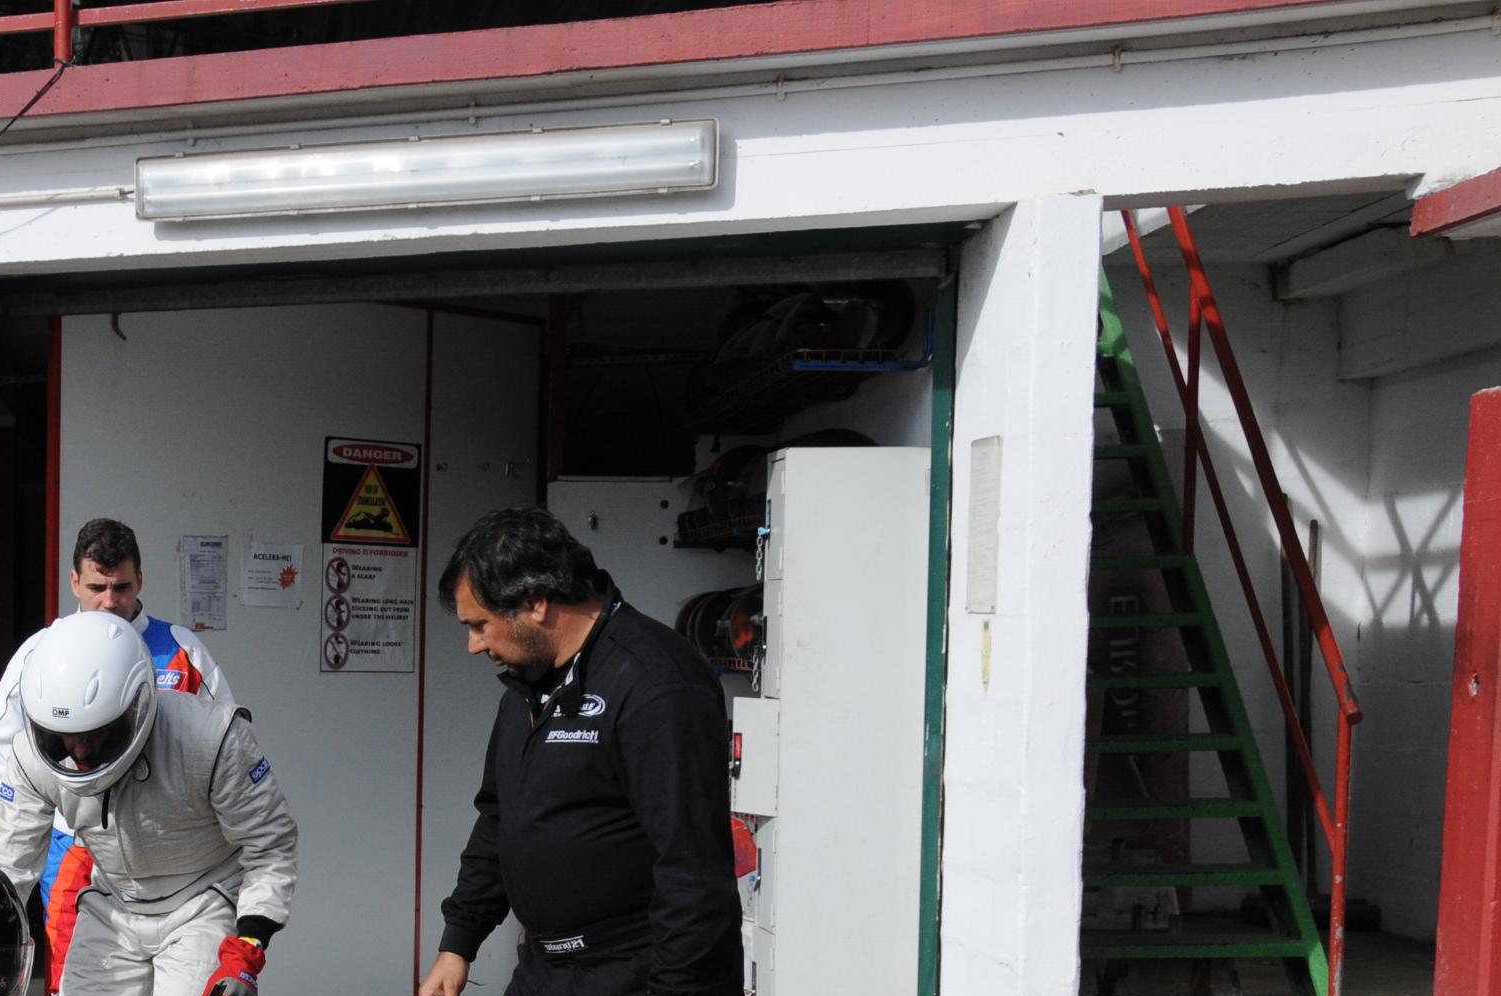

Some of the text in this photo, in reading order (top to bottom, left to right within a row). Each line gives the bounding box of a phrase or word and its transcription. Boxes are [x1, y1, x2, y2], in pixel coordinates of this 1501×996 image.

[342, 447, 402, 461] DANGER
[332, 547, 361, 555] DRIVING
[370, 549, 409, 557] FORBIDDEN
[52, 708, 70, 718] OMP
